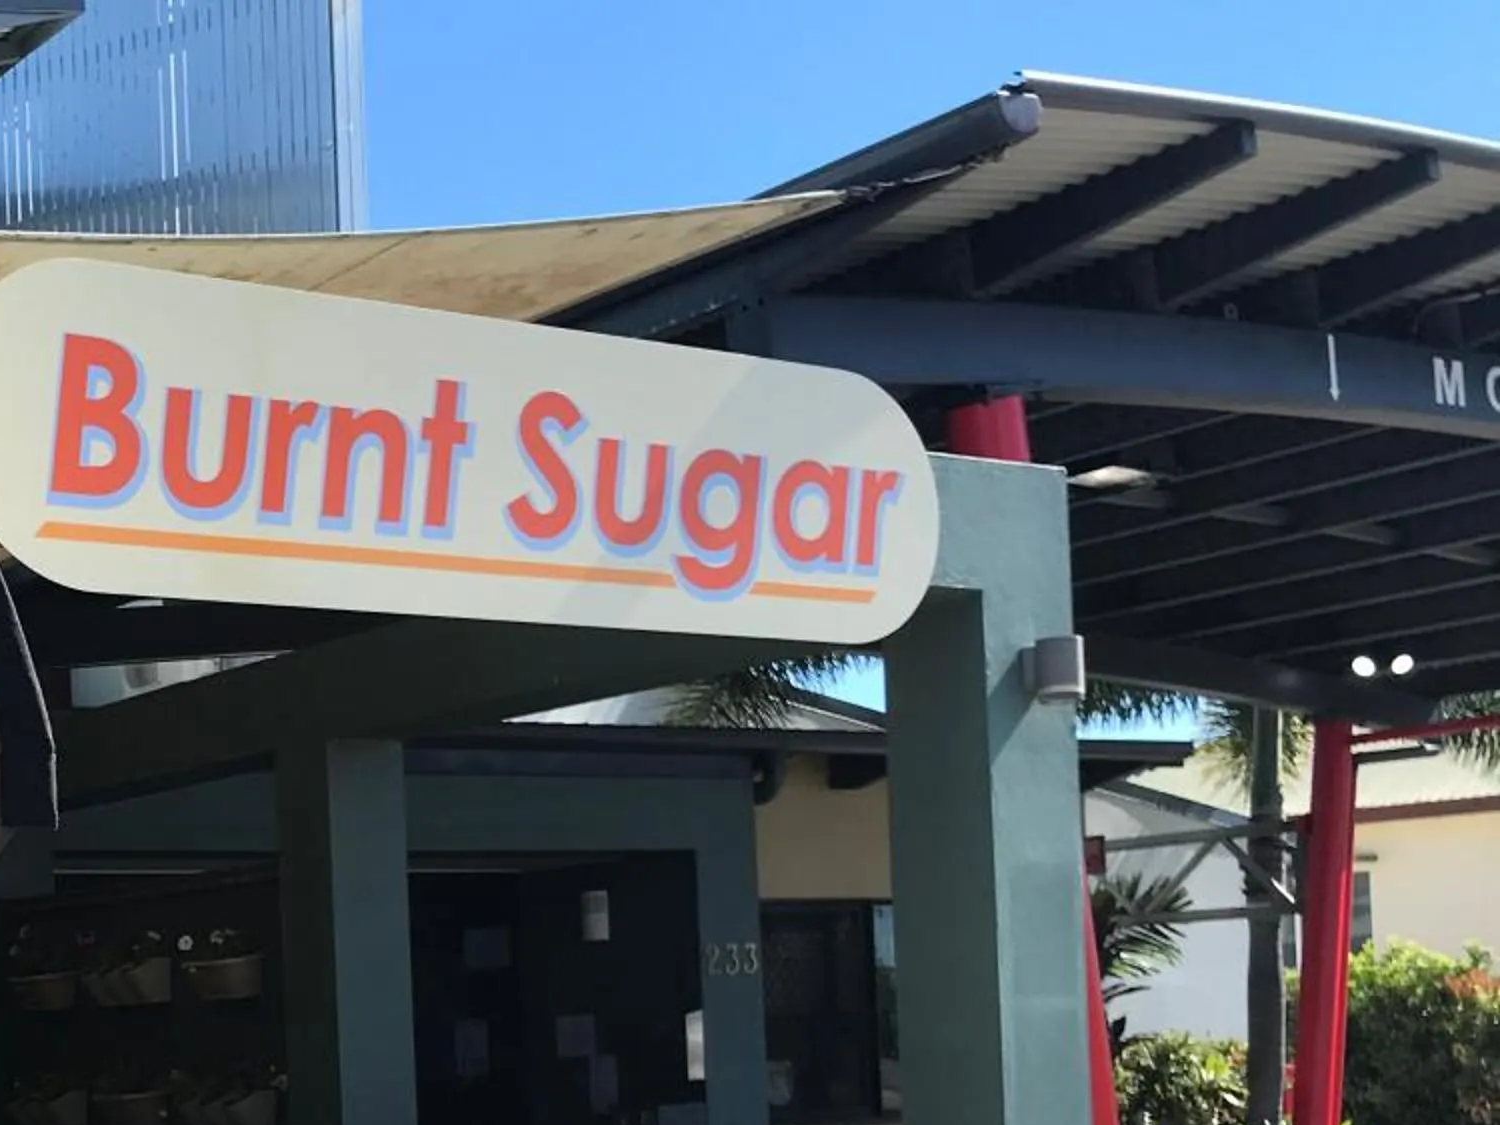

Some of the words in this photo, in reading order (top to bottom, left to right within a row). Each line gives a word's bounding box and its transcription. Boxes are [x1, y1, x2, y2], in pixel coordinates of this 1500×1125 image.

[47, 333, 475, 538] Burnt
[505, 391, 905, 602] Sugar
[705, 942, 759, 976] 233
